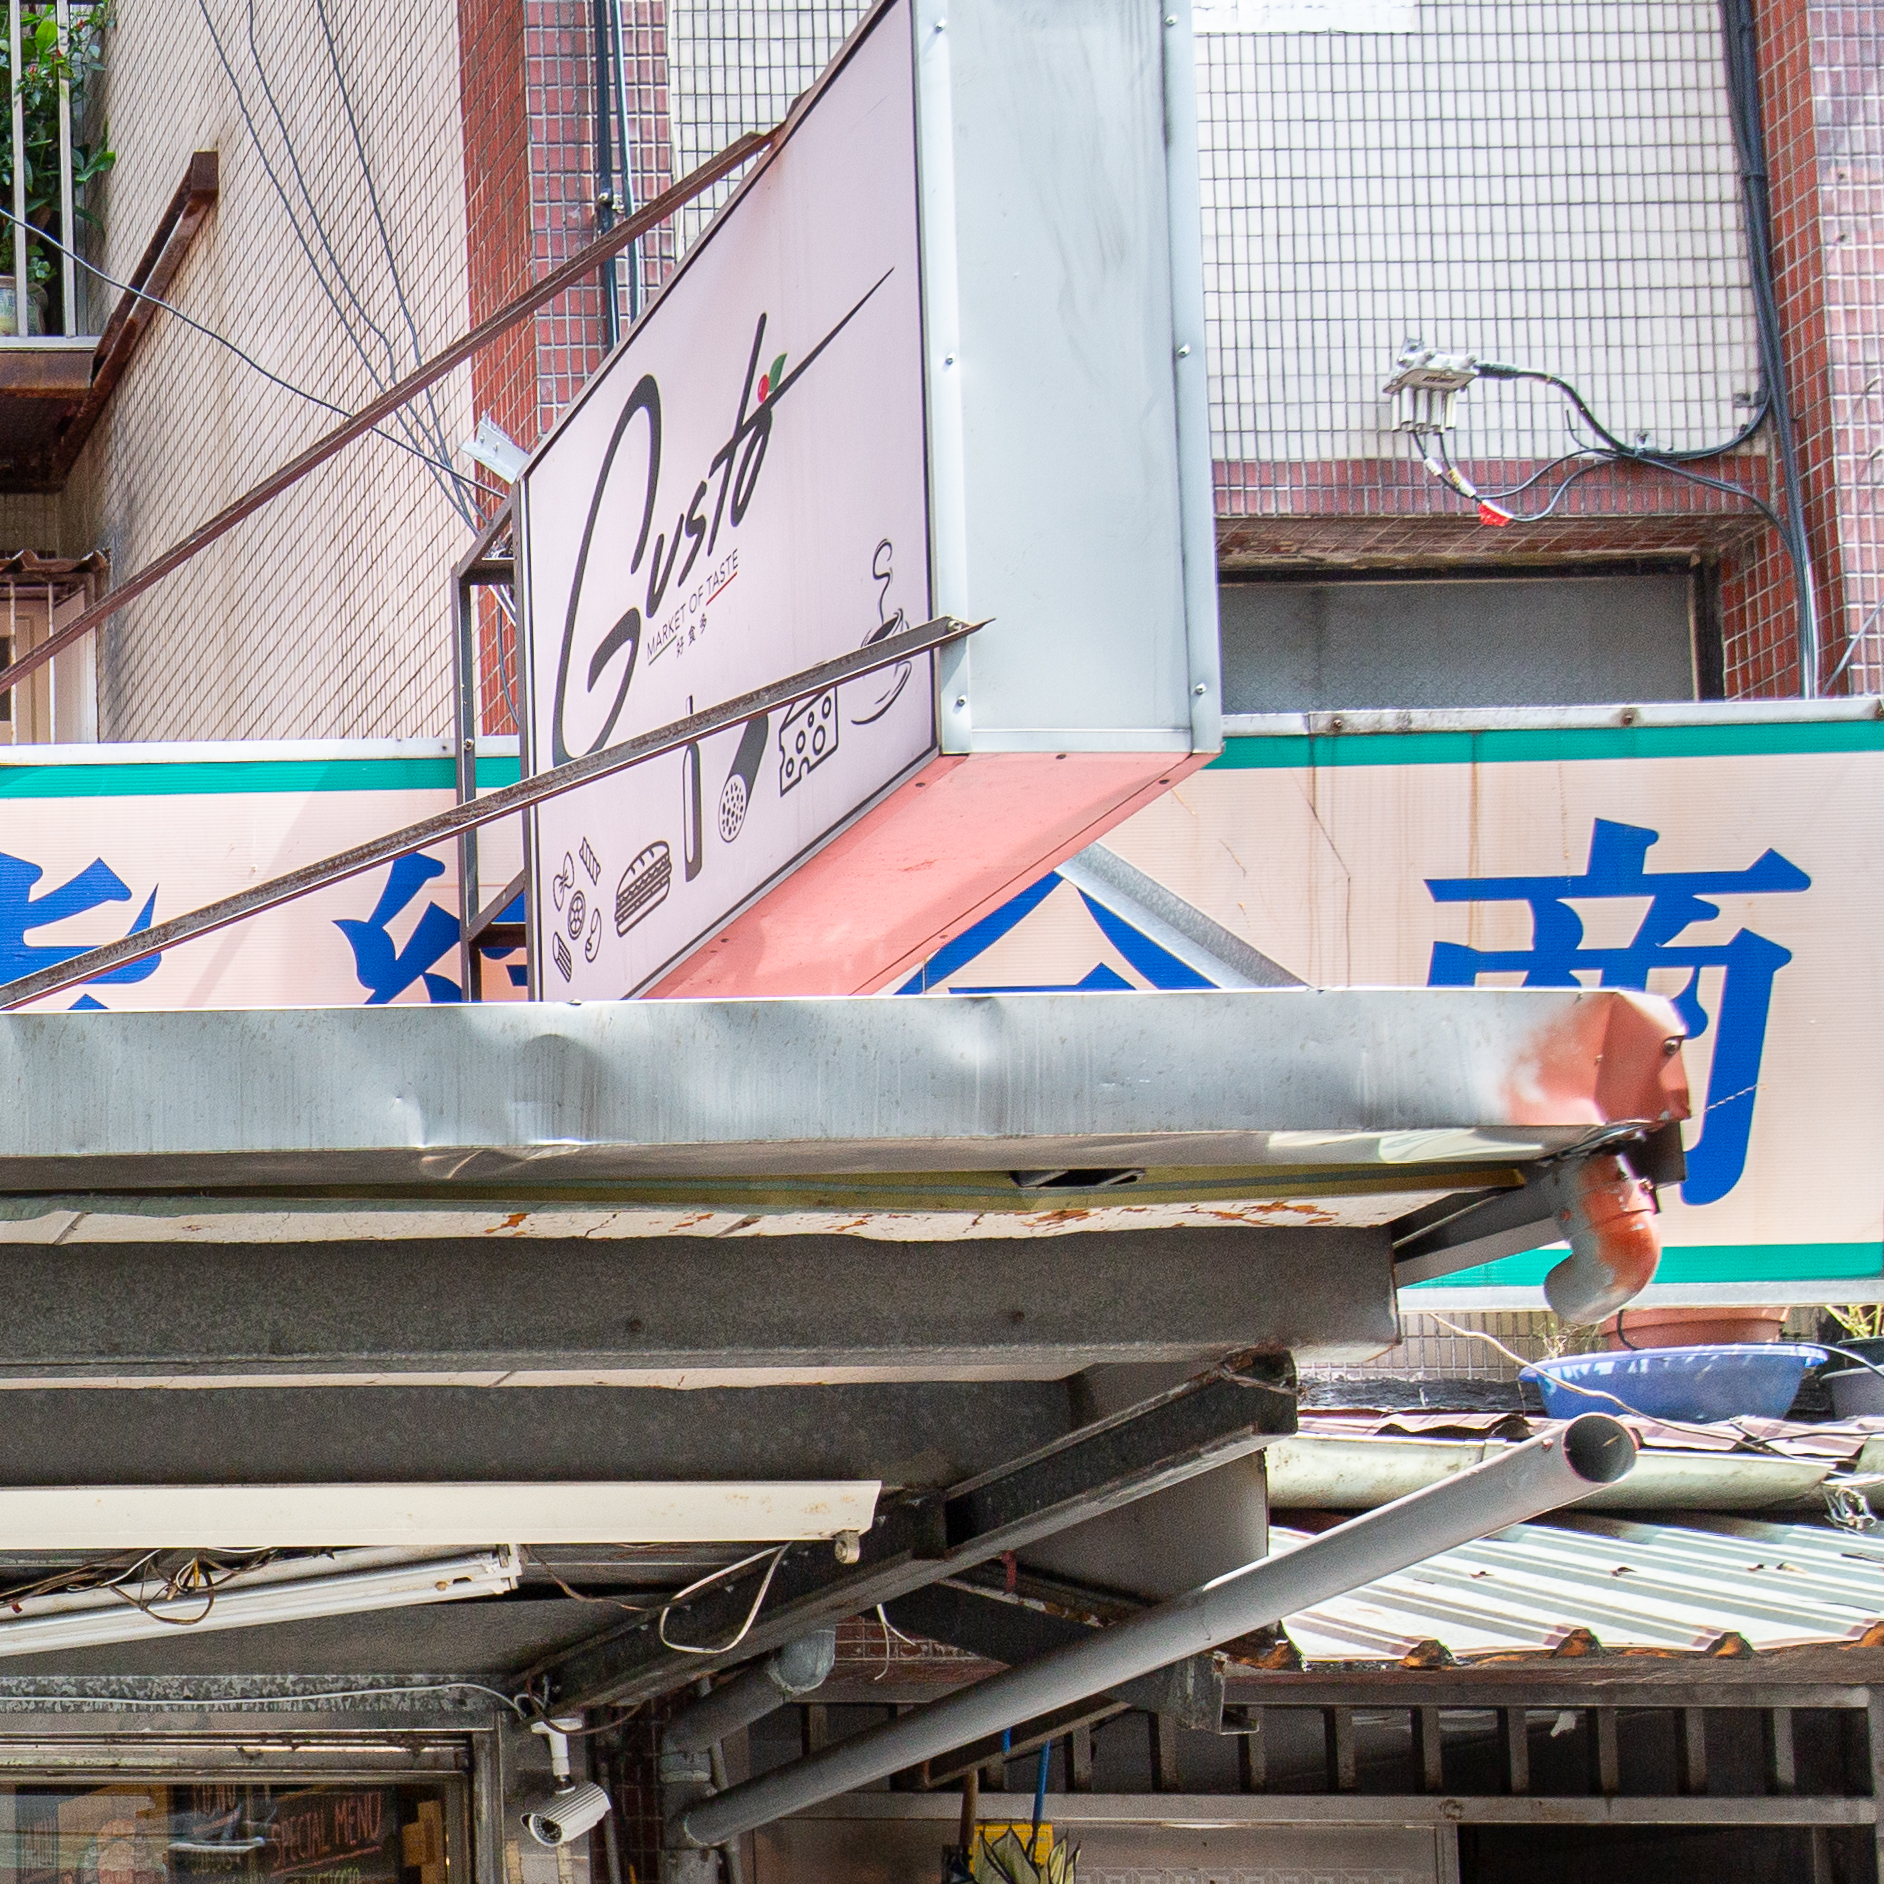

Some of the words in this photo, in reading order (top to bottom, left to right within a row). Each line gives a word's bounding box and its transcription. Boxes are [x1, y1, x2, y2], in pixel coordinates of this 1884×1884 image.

[553, 267, 894, 767] Gusto
[647, 602, 686, 660] MARKET
[689, 585, 703, 614] OF
[705, 548, 738, 595] TASTE
